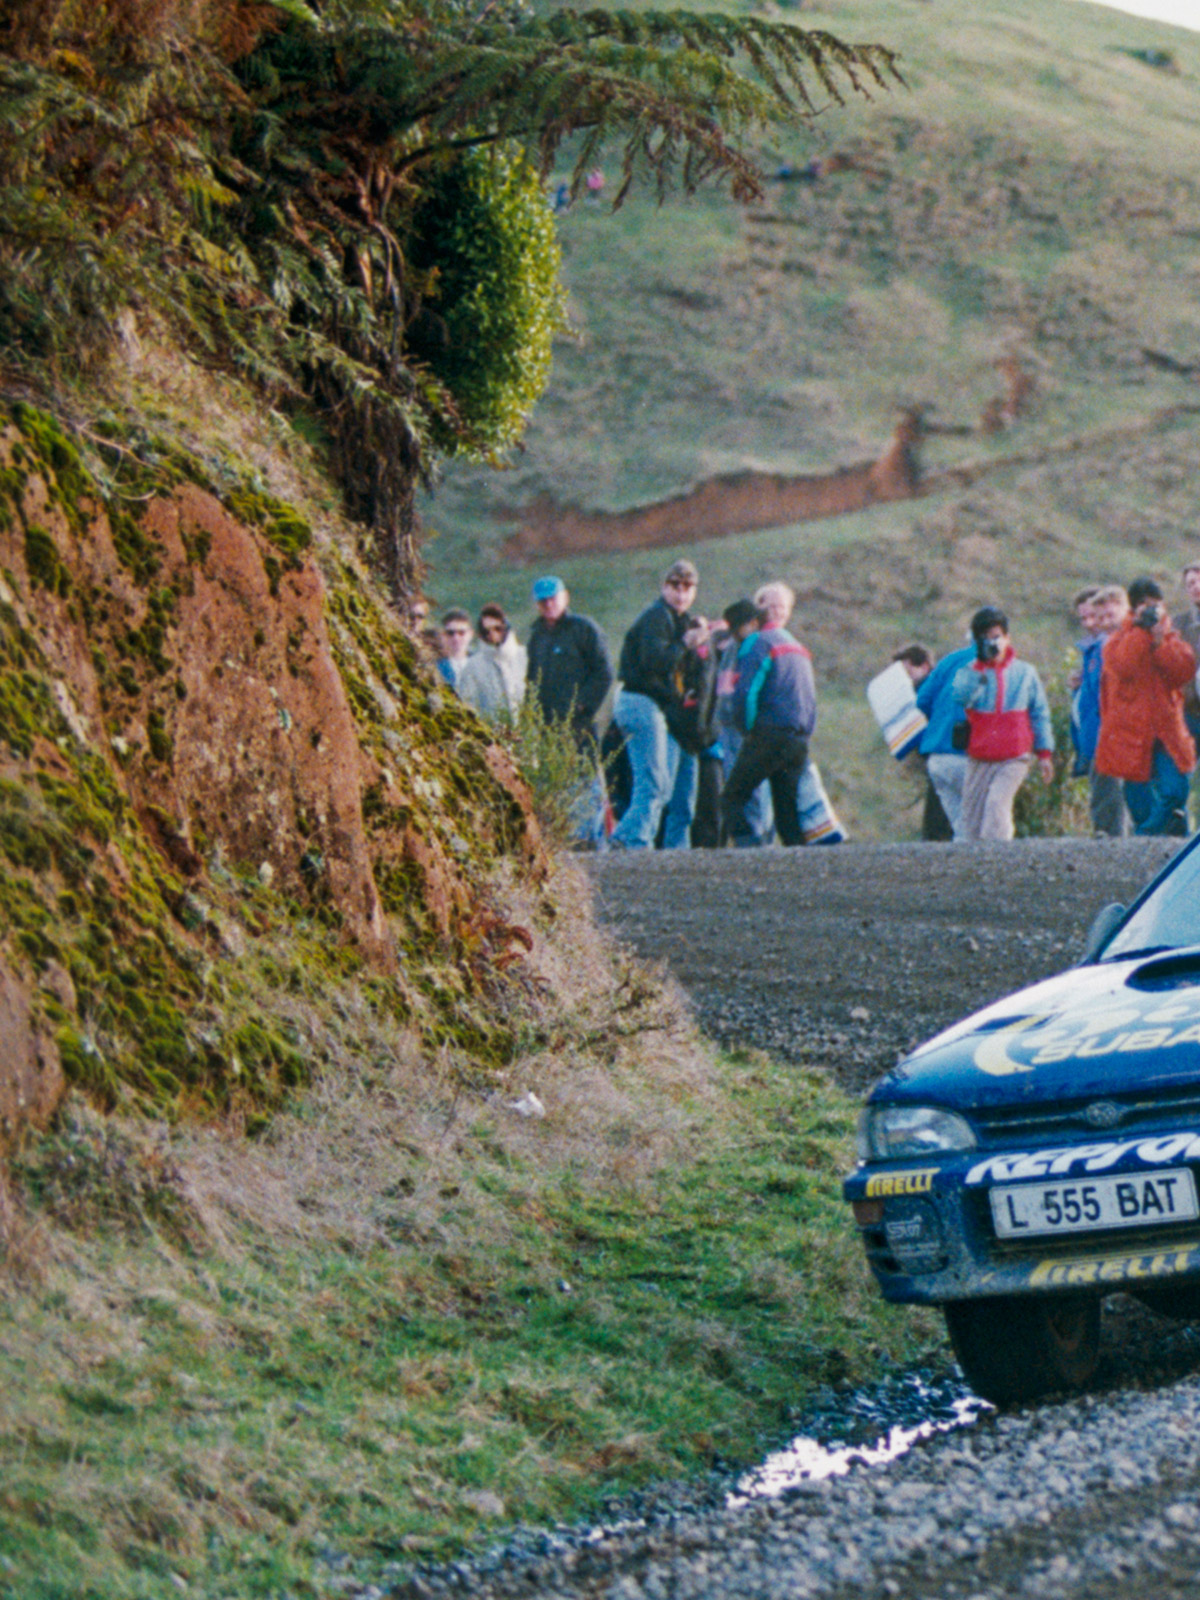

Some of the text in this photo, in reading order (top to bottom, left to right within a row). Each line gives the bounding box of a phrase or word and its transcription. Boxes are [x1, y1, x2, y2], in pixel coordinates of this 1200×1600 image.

[866, 1168, 941, 1197] PIRELLI
[1007, 1178, 1177, 1228] L 555 BAT
[1029, 1243, 1199, 1286] PIRELLI
